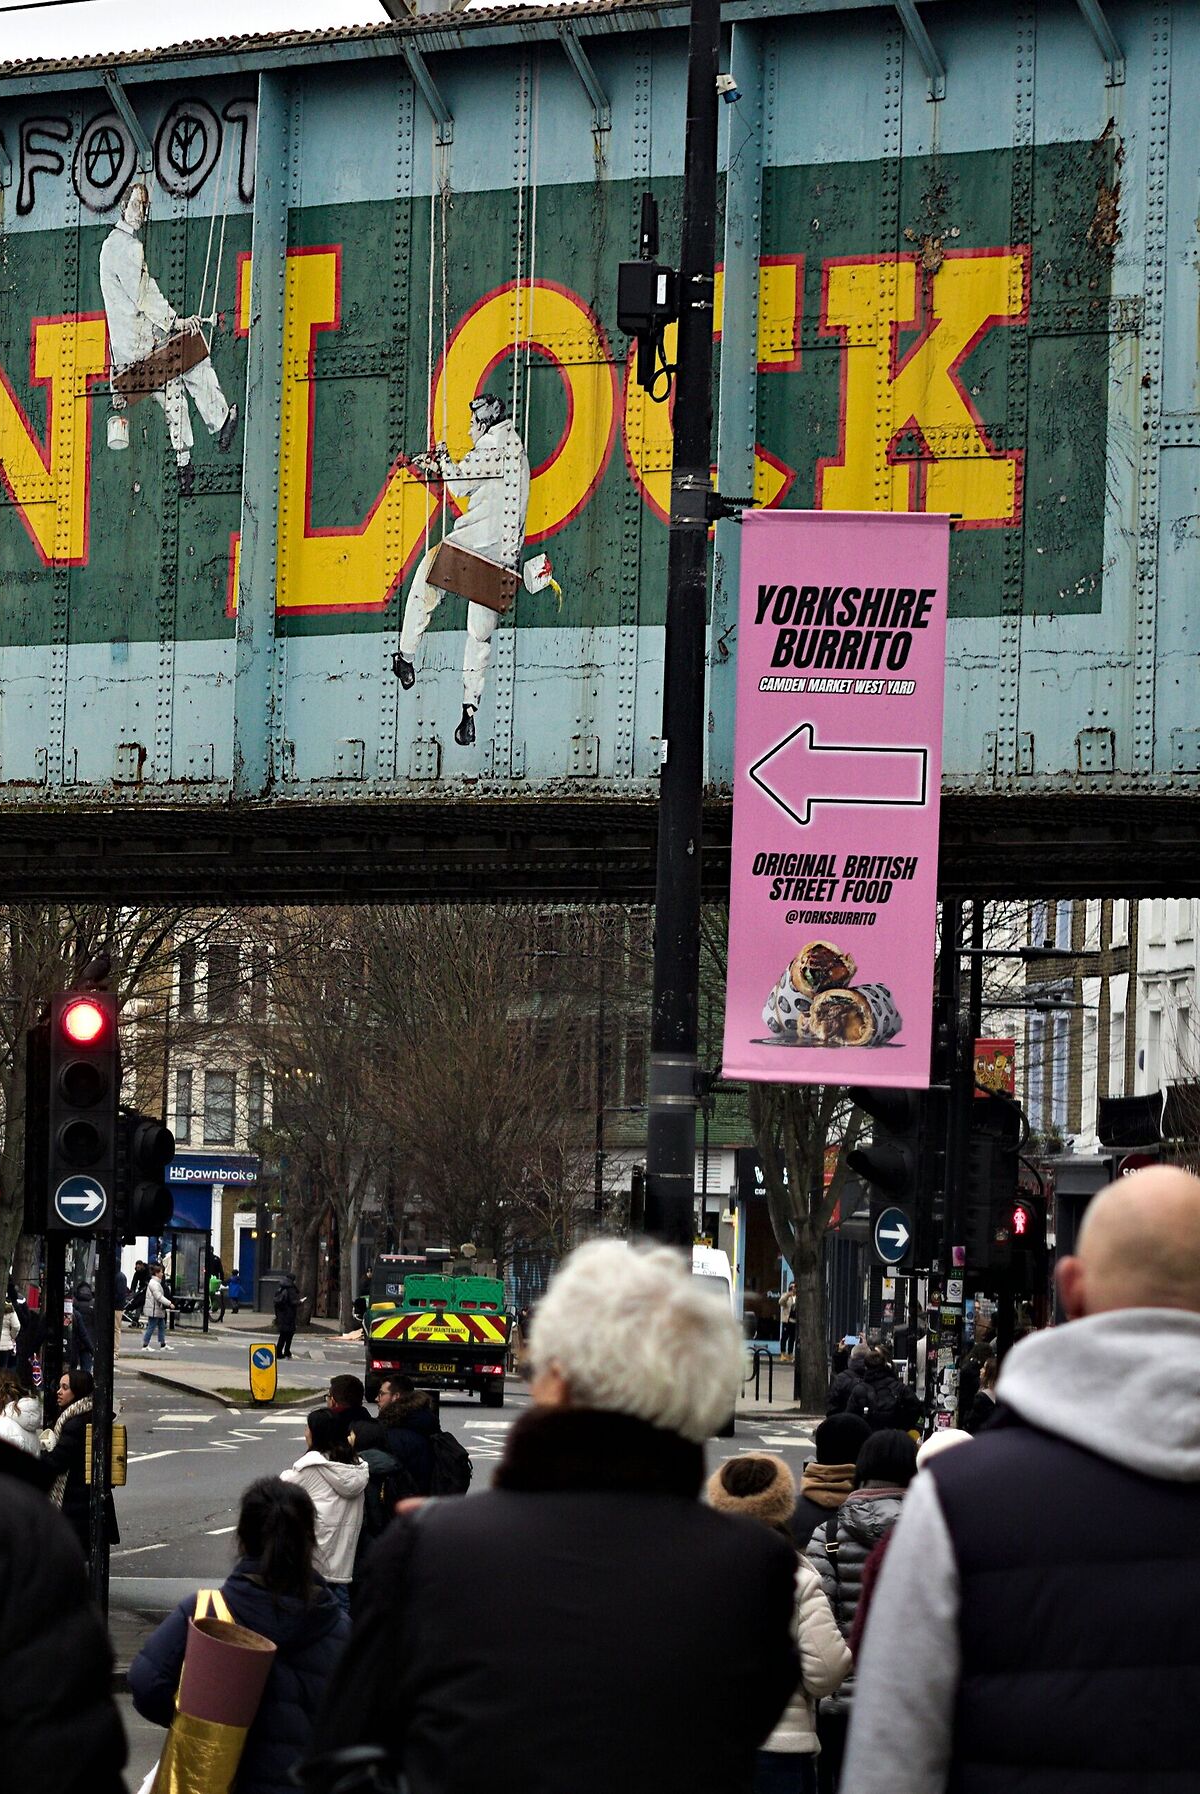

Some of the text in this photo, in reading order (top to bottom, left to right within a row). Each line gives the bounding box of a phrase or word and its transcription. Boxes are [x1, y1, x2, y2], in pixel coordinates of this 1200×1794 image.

[227, 243, 1033, 617] LOCK
[754, 584, 937, 629] YORKSHIRE
[770, 628, 913, 671] BURRITO
[759, 676, 916, 695] CAMDEN MARKET WEST YARD
[752, 852, 918, 880] ORIGINAL BRITISH
[769, 877, 893, 903] STREET FOOD
[785, 909, 877, 926] @YORKSBURRITO
